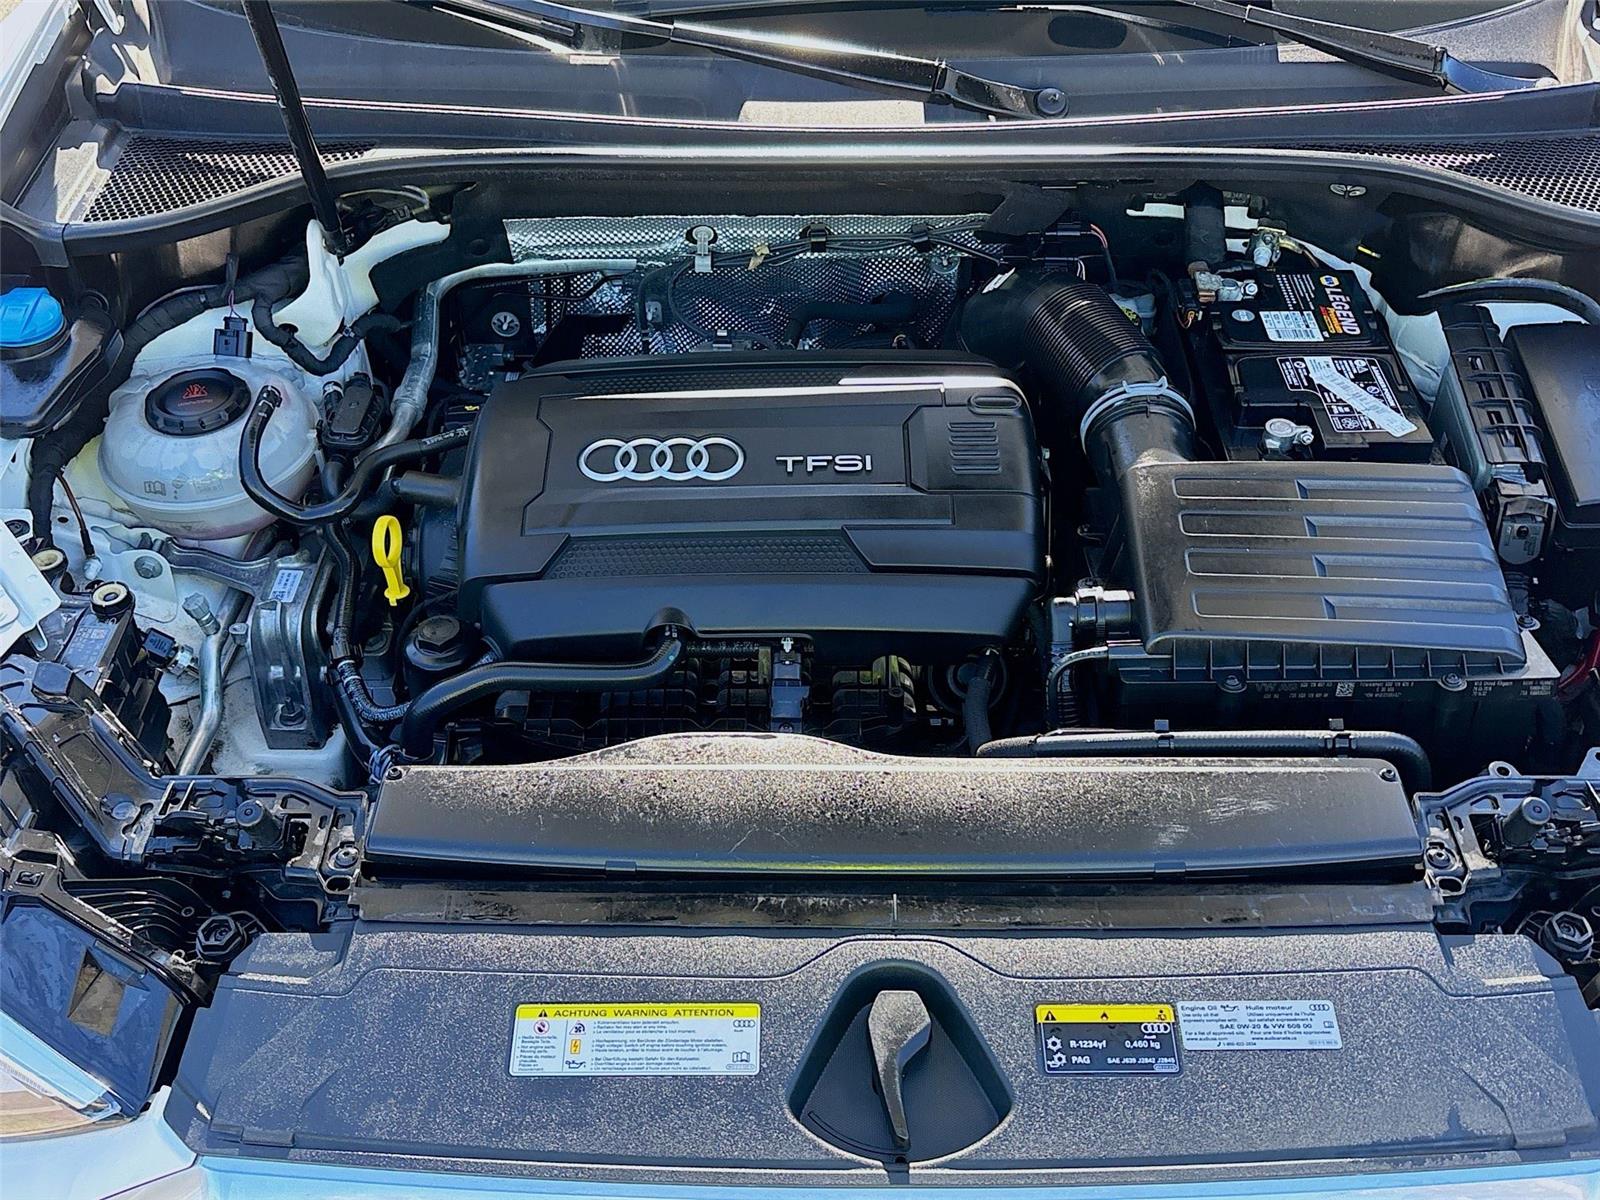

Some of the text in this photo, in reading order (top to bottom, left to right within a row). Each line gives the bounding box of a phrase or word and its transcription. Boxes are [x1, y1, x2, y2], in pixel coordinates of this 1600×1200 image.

[776, 455, 872, 472] TFSI
[554, 1008, 734, 1017] ACHTUNG WARNING ATTENTION
[1069, 1040, 1106, 1050] R-1234yf
[1149, 1040, 1160, 1050] kg
[1071, 1056, 1090, 1064] PAG
